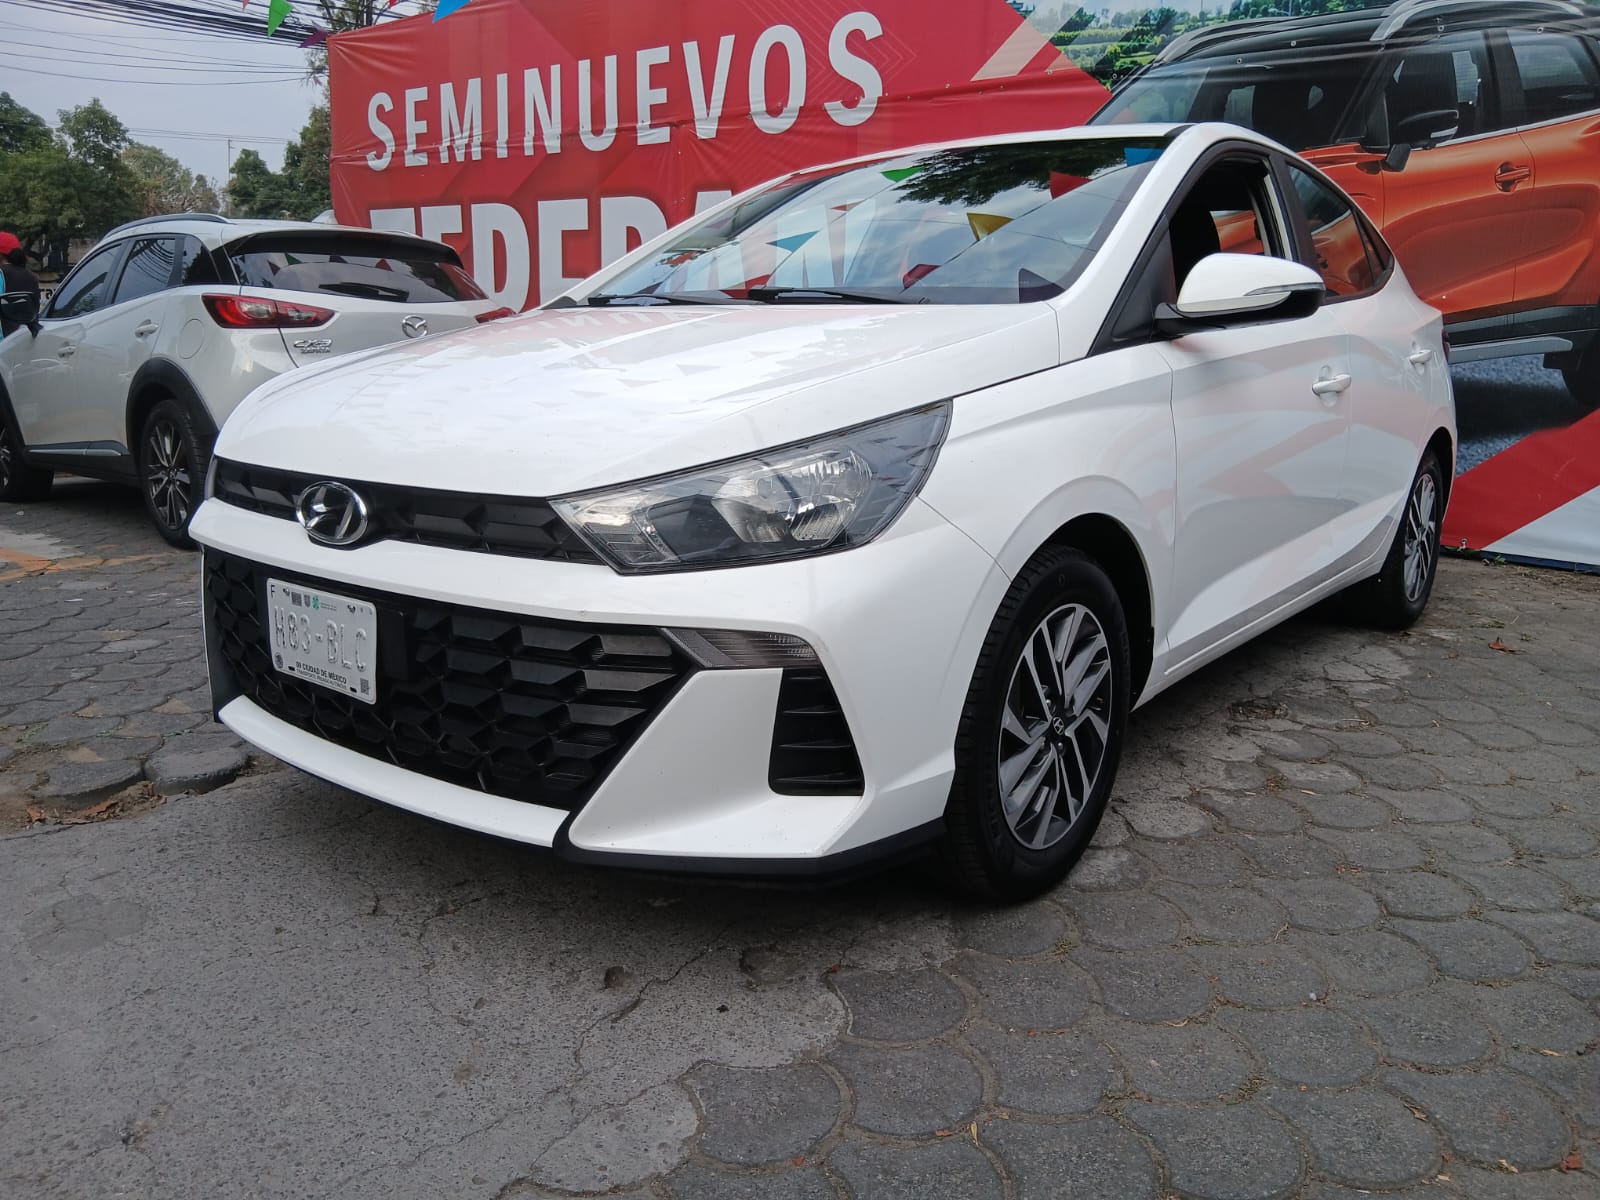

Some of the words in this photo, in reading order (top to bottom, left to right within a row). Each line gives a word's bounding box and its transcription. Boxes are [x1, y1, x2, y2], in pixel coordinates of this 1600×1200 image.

[366, 11, 883, 171] SEMINUEVOS
[302, 663, 321, 675] CIUDAD
[320, 669, 328, 678] DE
